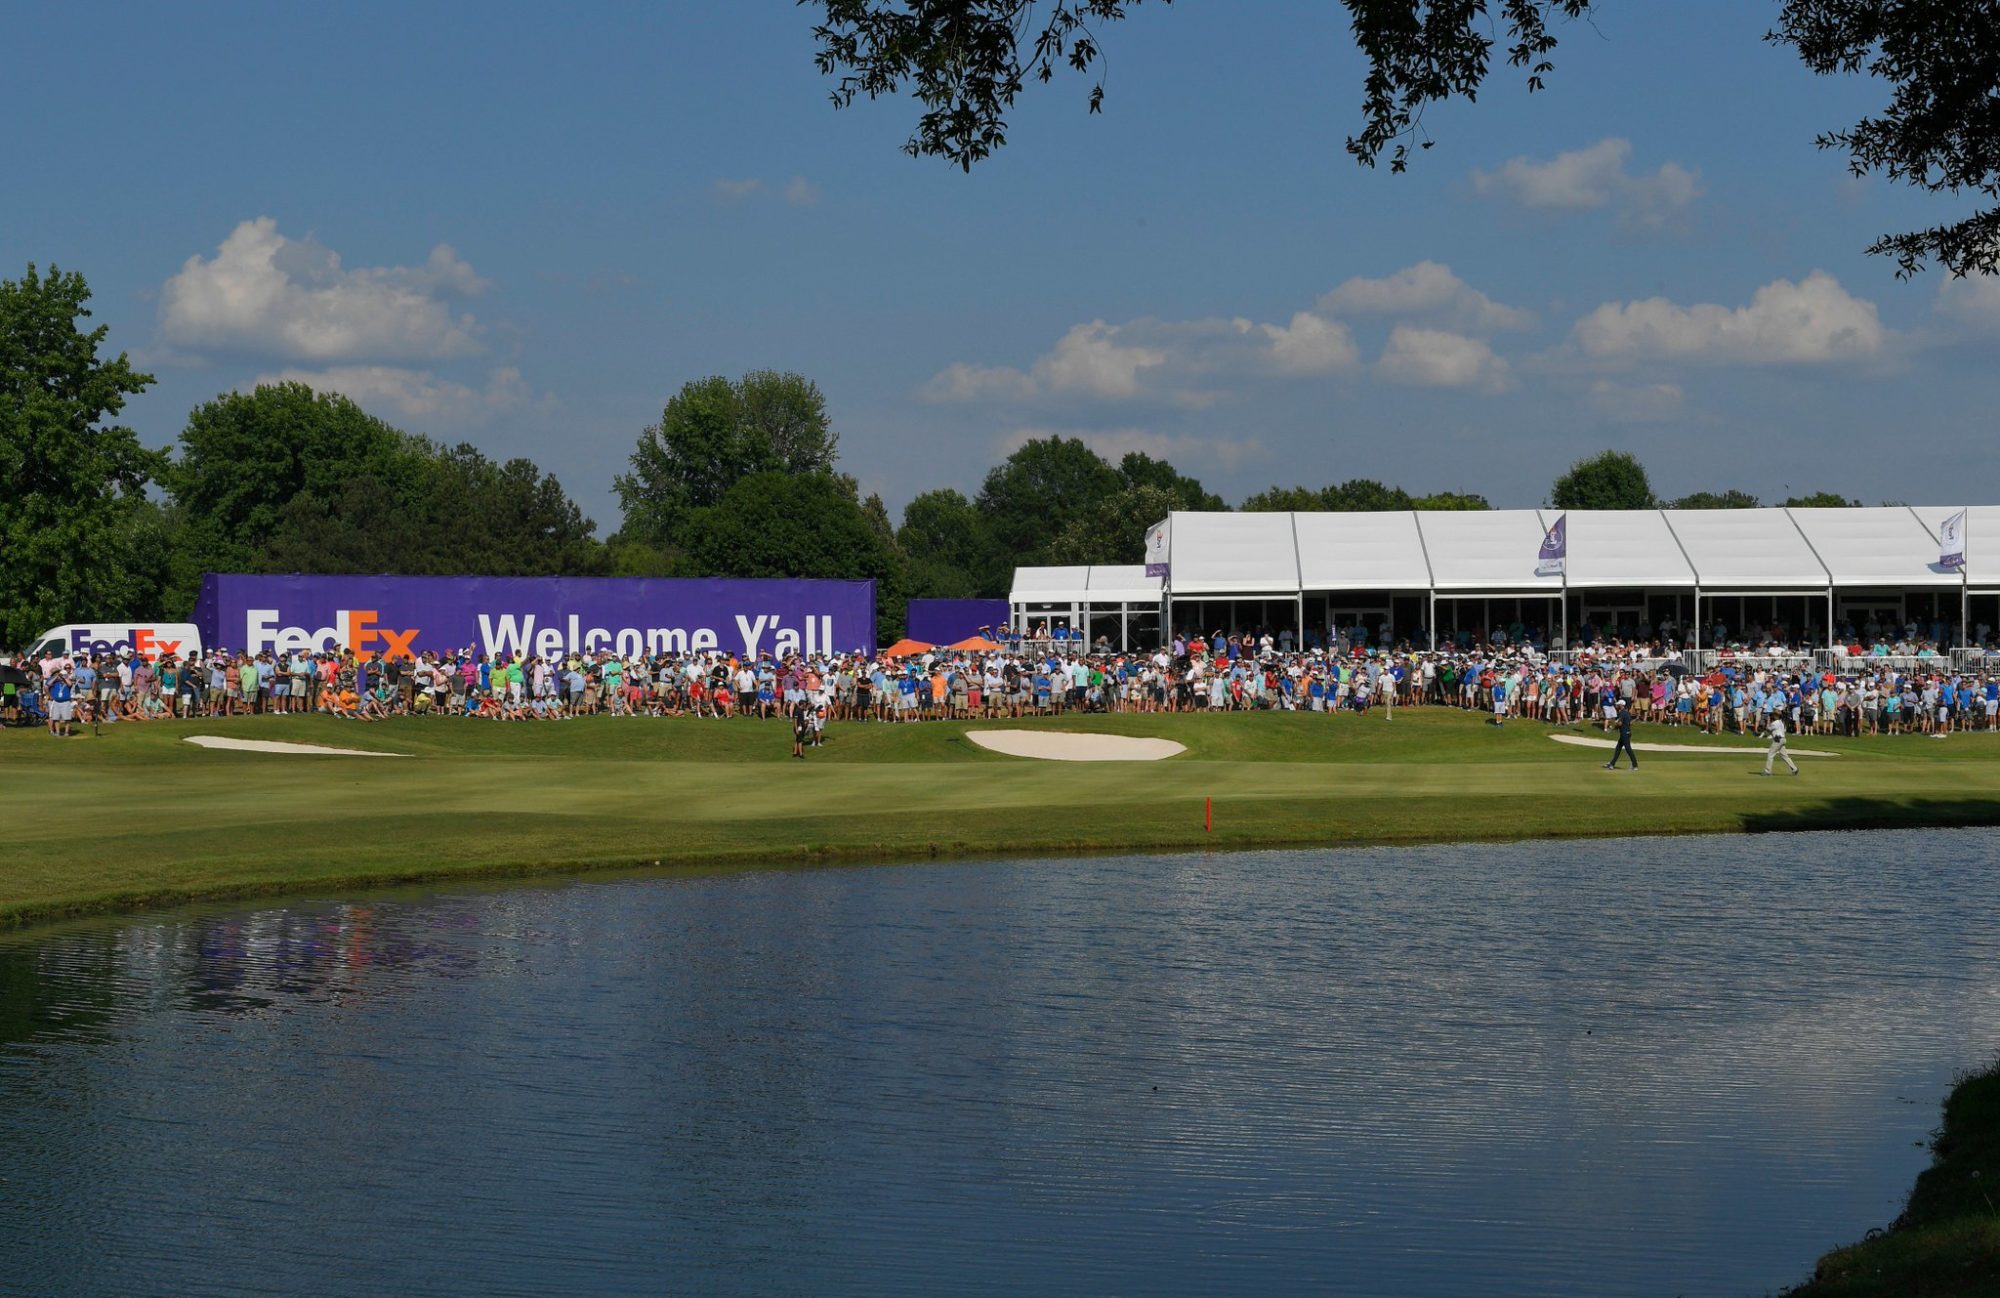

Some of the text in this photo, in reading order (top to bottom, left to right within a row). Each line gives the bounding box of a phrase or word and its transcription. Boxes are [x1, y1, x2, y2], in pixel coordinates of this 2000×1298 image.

[71, 629, 183, 661] FedEx
[247, 610, 420, 663] FedEx
[478, 614, 832, 664] Welcome Y'all
